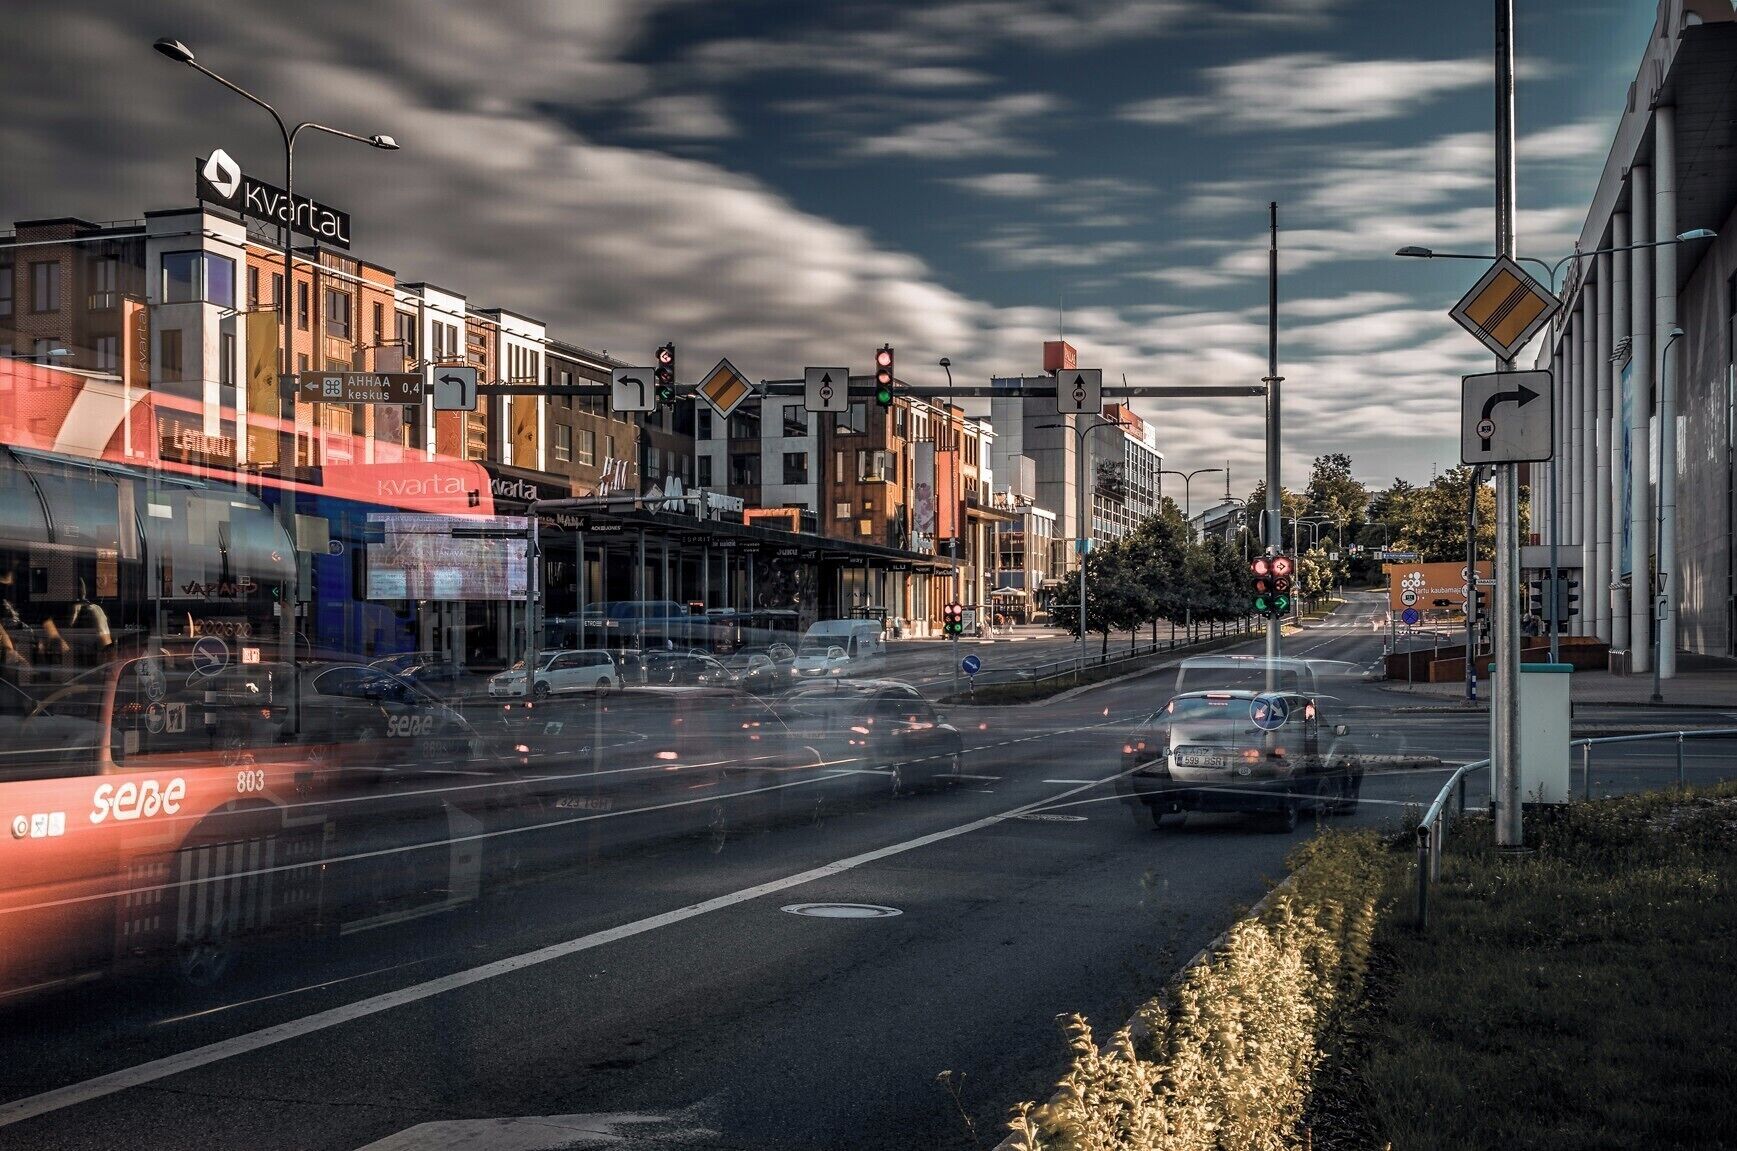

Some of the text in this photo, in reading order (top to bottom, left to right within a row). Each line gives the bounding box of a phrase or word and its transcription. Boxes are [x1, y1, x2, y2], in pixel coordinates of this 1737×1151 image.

[348, 376, 420, 395] AHHAA 0,4
[348, 389, 390, 400] keskus
[1184, 756, 1199, 765] 599
[237, 769, 265, 793] 803
